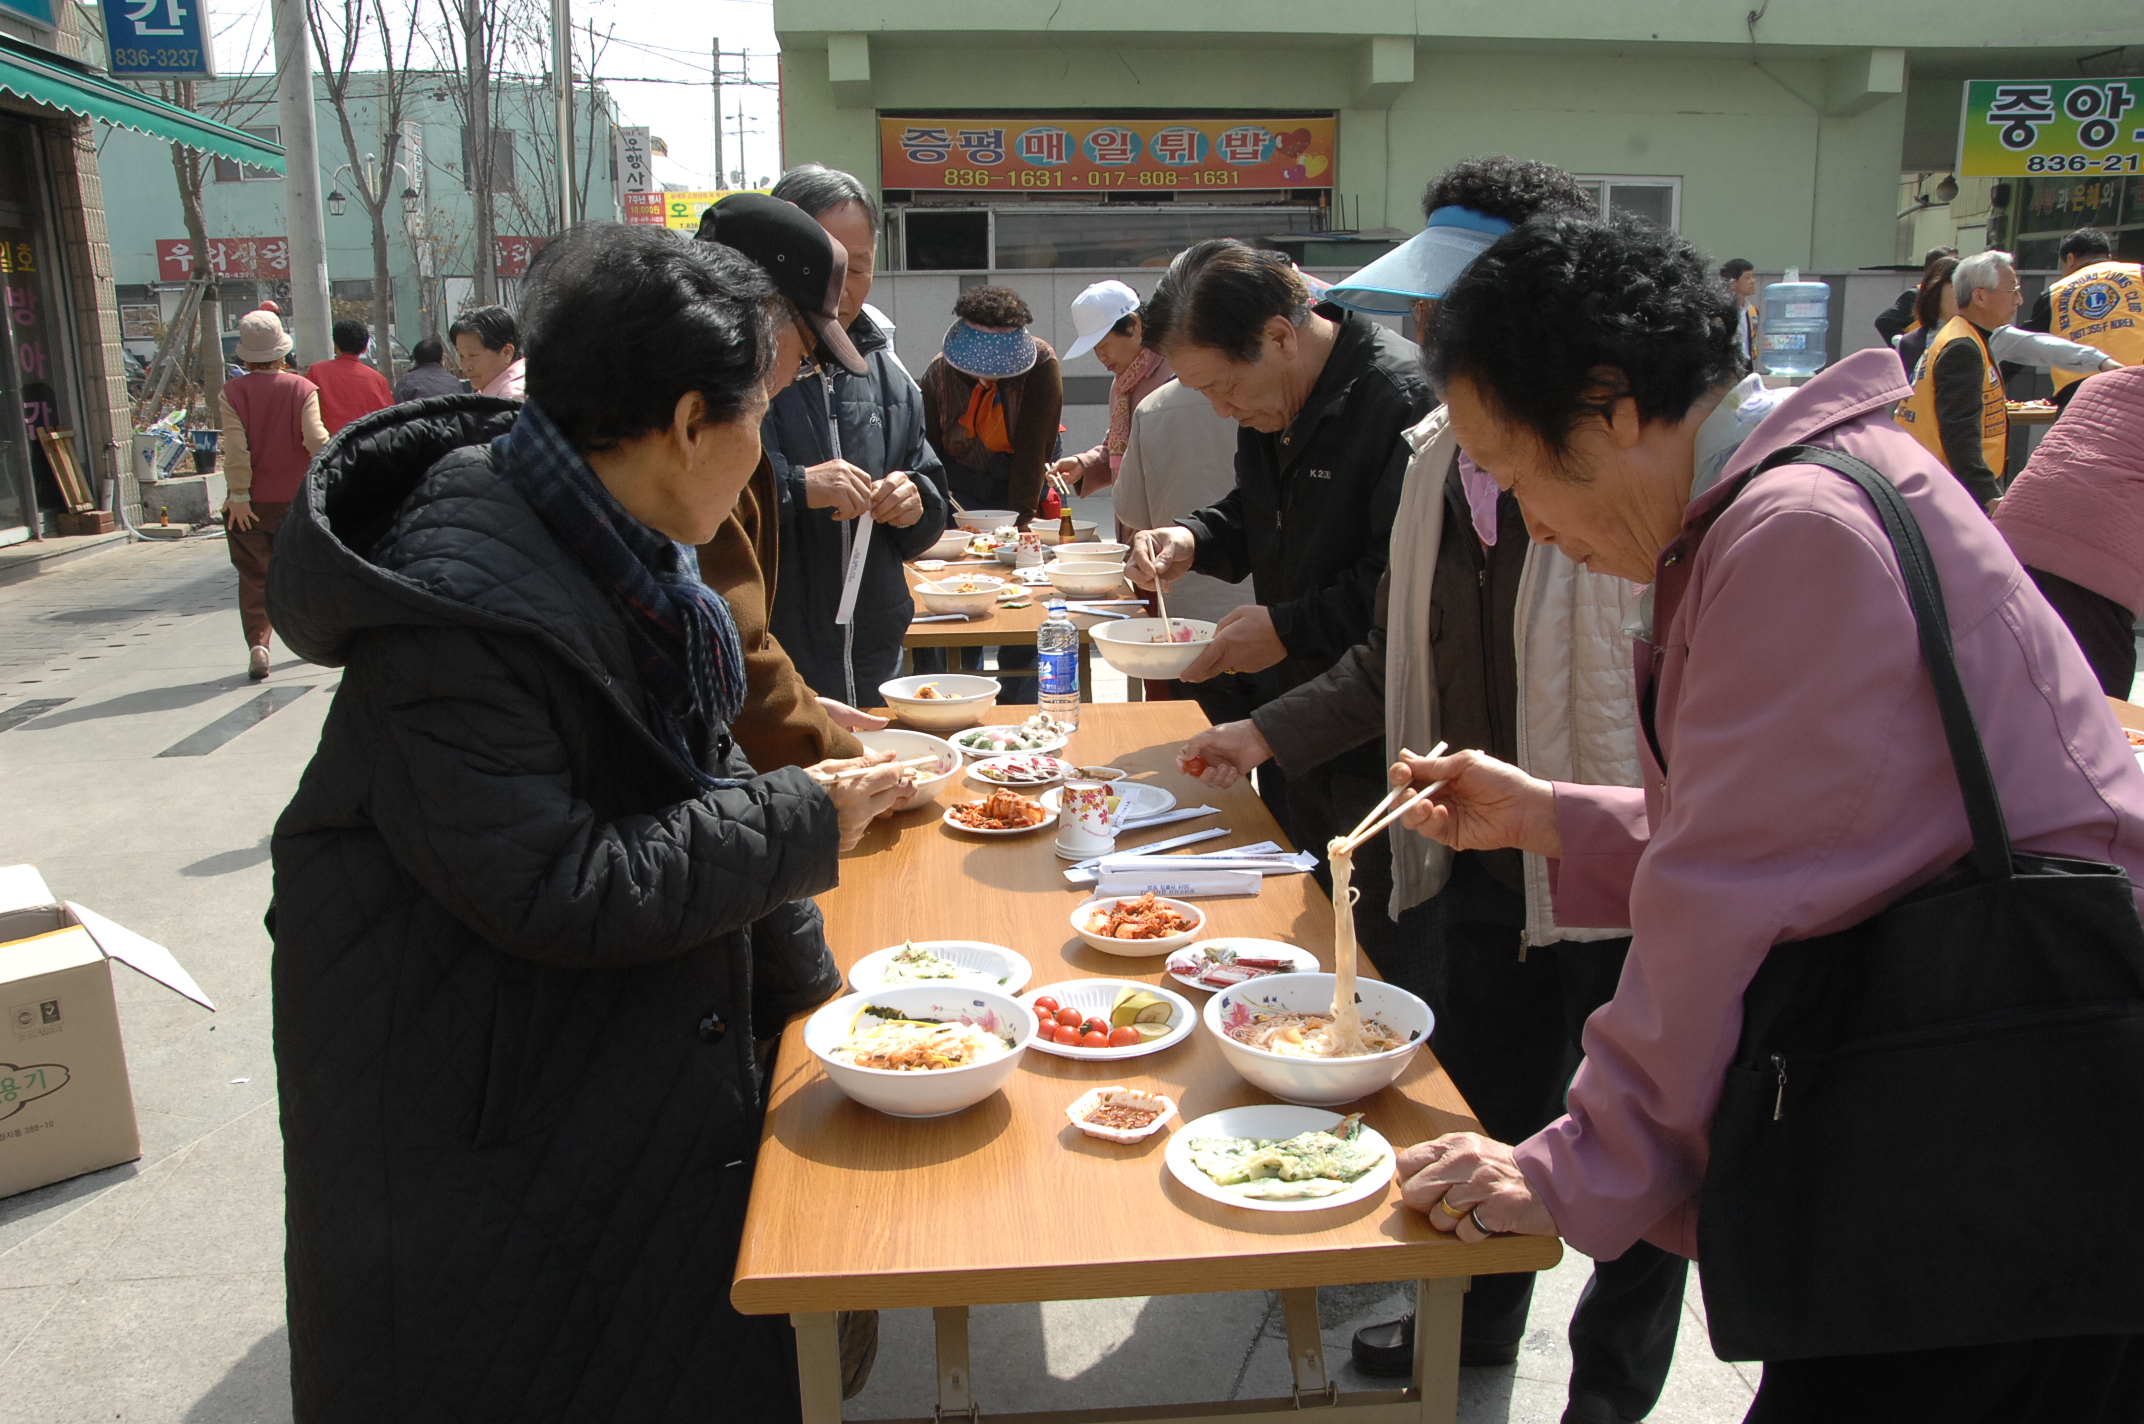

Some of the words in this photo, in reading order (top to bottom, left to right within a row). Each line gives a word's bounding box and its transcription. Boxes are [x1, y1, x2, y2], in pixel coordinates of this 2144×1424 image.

[115, 48, 199, 67] 836-3237
[1986, 83, 2136, 152] 중앙
[899, 126, 1007, 165] 증평
[625, 138, 645, 192] 오행사
[944, 168, 1063, 187] 836-1631
[1087, 170, 1240, 186] 017-808-1631
[2026, 154, 2144, 173] 836-21
[0, 1068, 47, 1102] 용기
